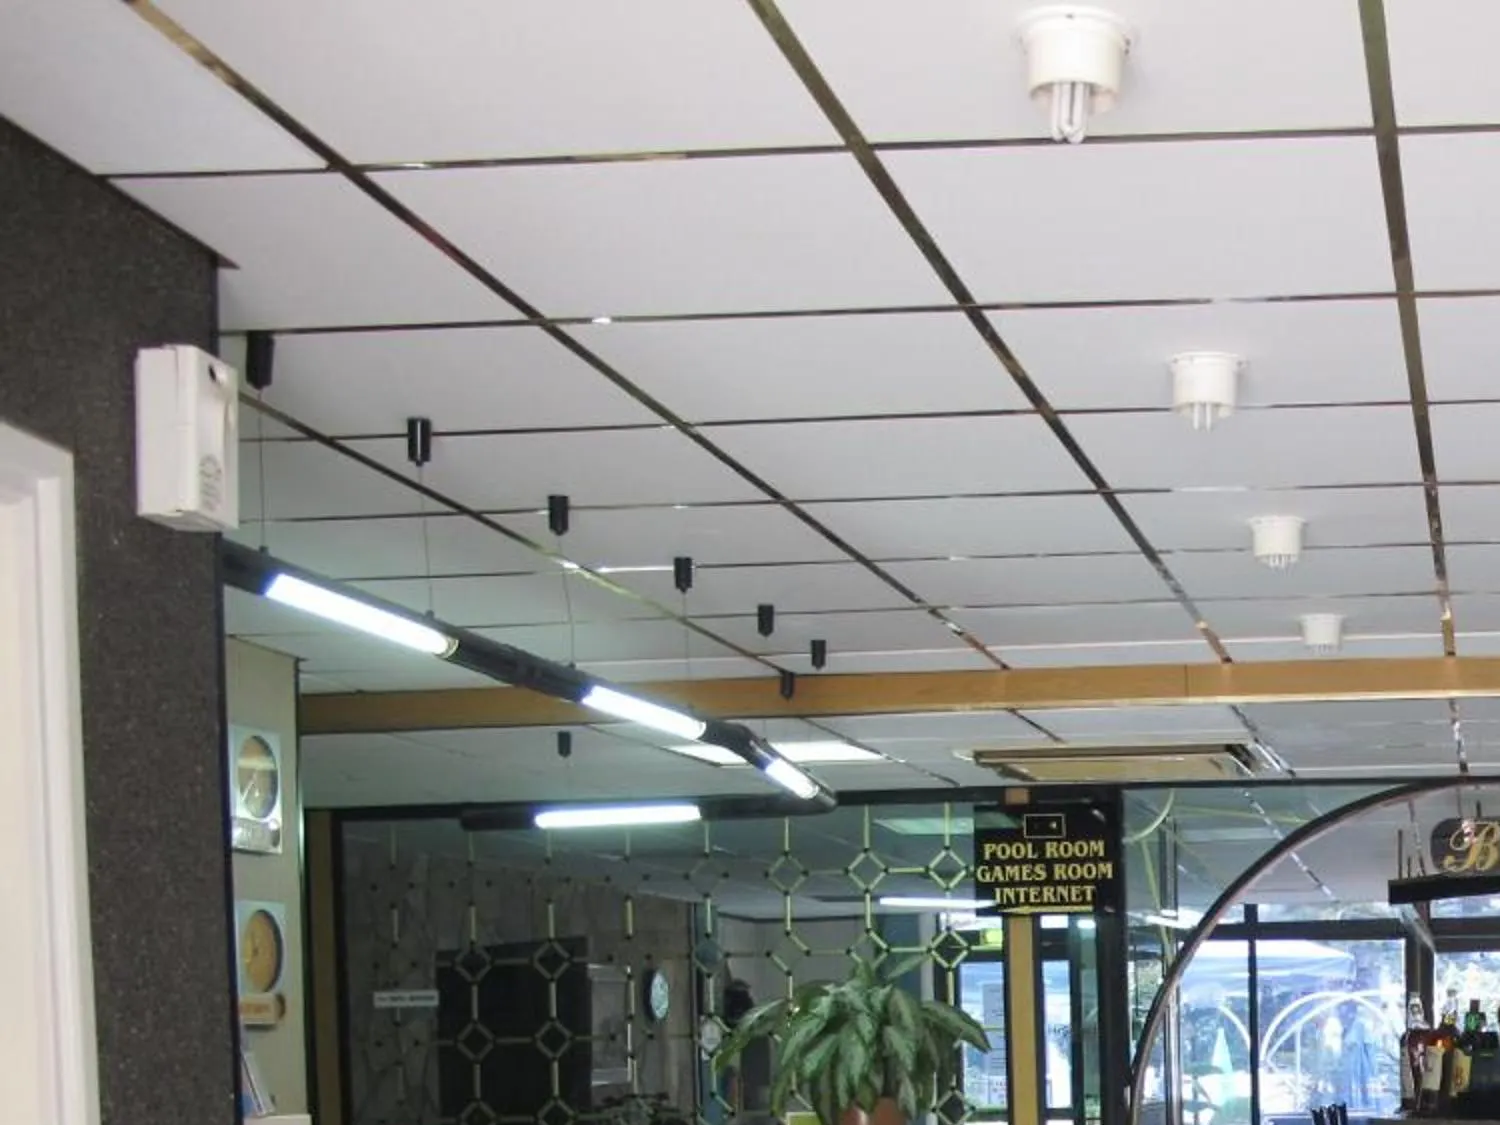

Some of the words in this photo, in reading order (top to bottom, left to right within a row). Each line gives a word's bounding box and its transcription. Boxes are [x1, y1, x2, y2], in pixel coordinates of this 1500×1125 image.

[983, 842, 1039, 860] POOL
[1045, 840, 1105, 858] ROOM
[977, 864, 1047, 882] GAMES
[1053, 862, 1113, 880] ROOM
[994, 885, 1096, 905] INTERNET
